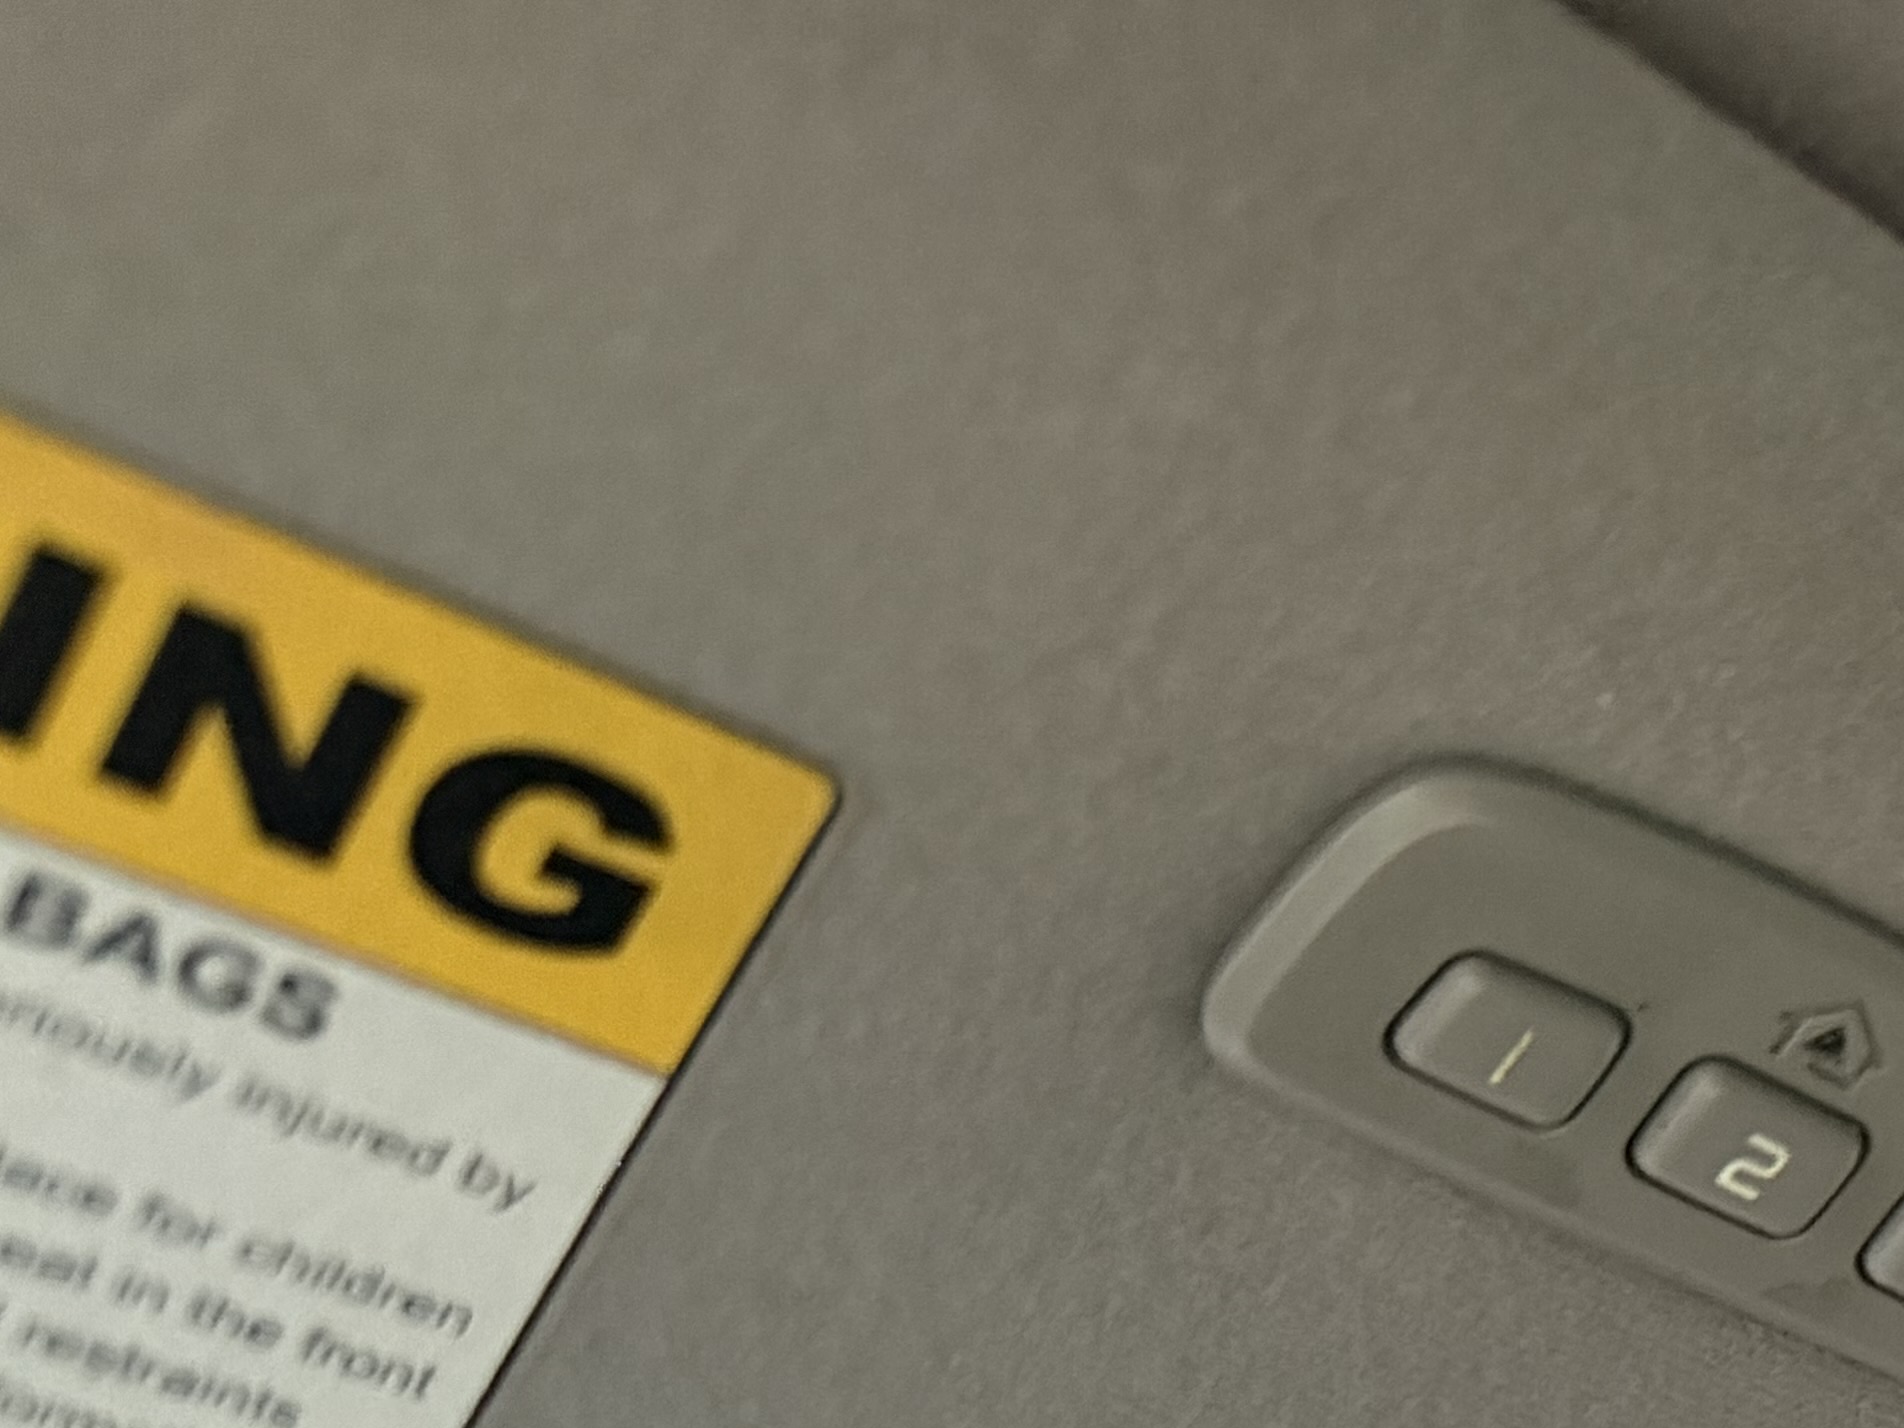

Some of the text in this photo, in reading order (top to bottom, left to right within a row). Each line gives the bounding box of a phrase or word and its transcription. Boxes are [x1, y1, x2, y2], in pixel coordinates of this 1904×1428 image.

[4, 872, 338, 1042] BAGS
[0, 1000, 536, 1213] riously injured by
[1714, 1132, 1791, 1201] 2
[111, 1266, 169, 1313] in
[184, 1289, 284, 1348] the
[302, 1325, 437, 1400] front
[136, 1193, 218, 1247] for
[235, 1234, 474, 1337] children
